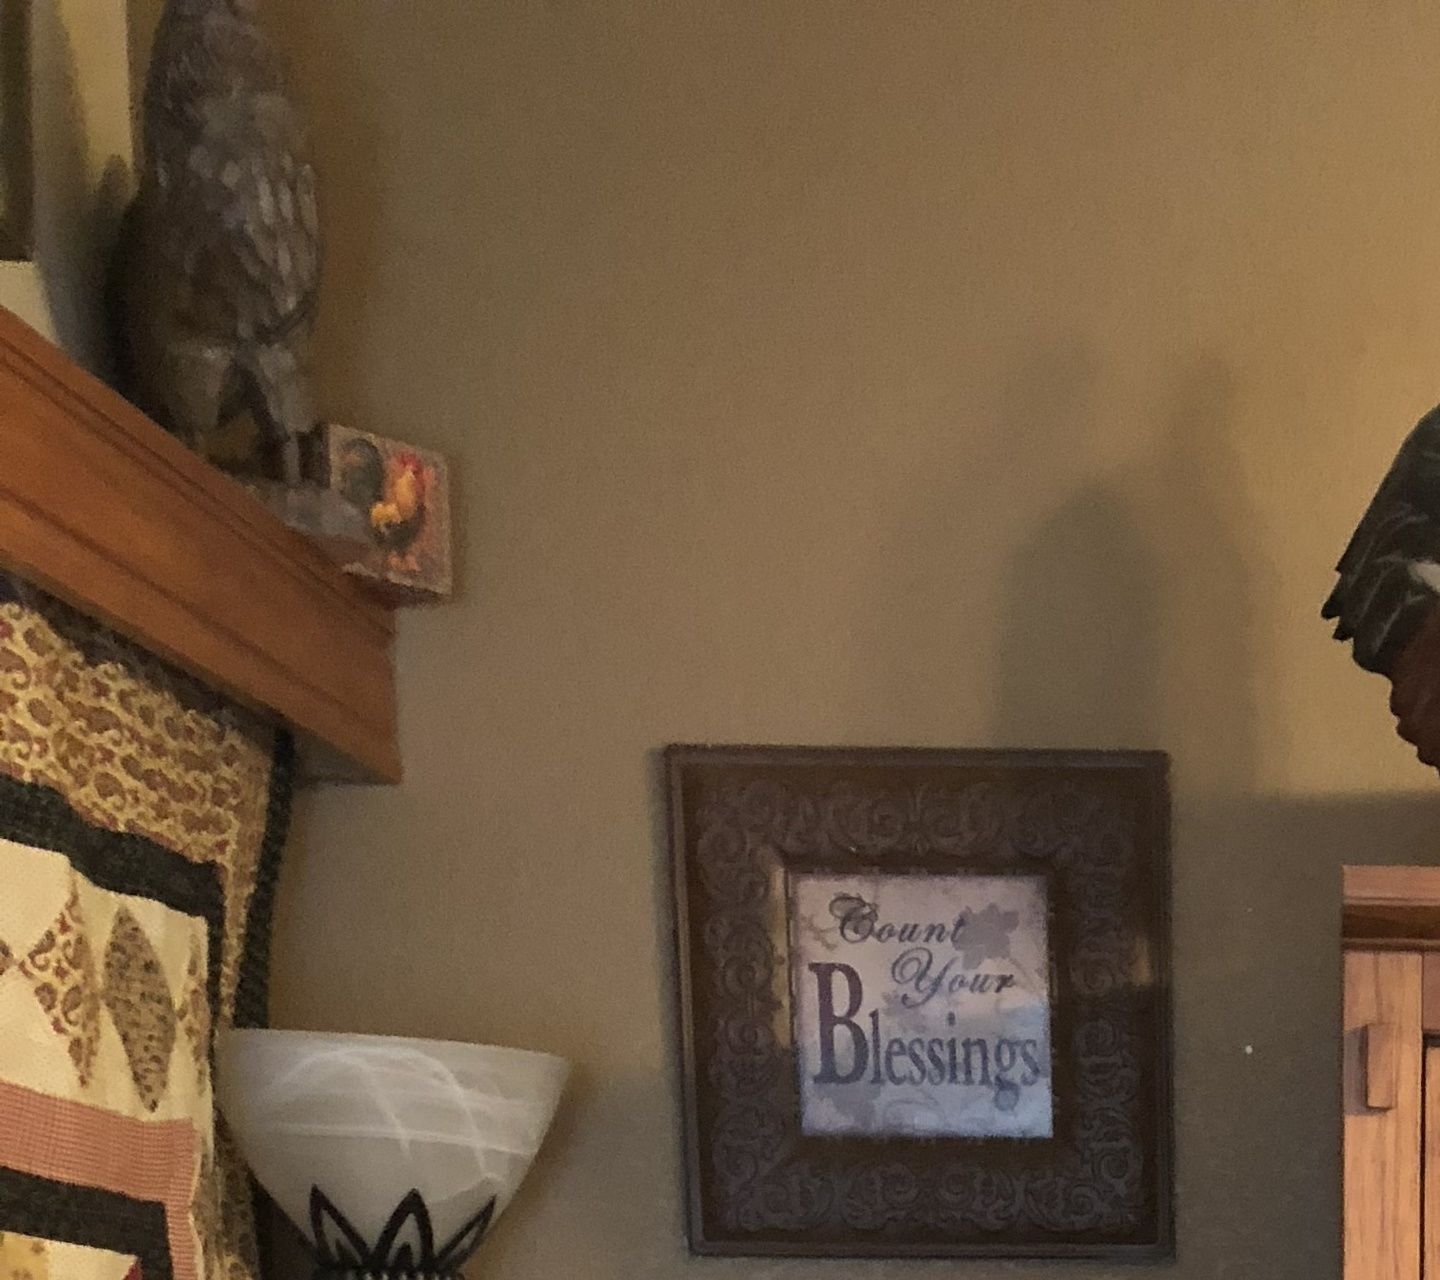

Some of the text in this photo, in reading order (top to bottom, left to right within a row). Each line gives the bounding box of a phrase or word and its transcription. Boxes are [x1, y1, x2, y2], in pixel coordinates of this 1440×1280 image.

[829, 893, 968, 944] Count
[891, 947, 1017, 1009] Your
[808, 962, 1041, 1112] Blessings
